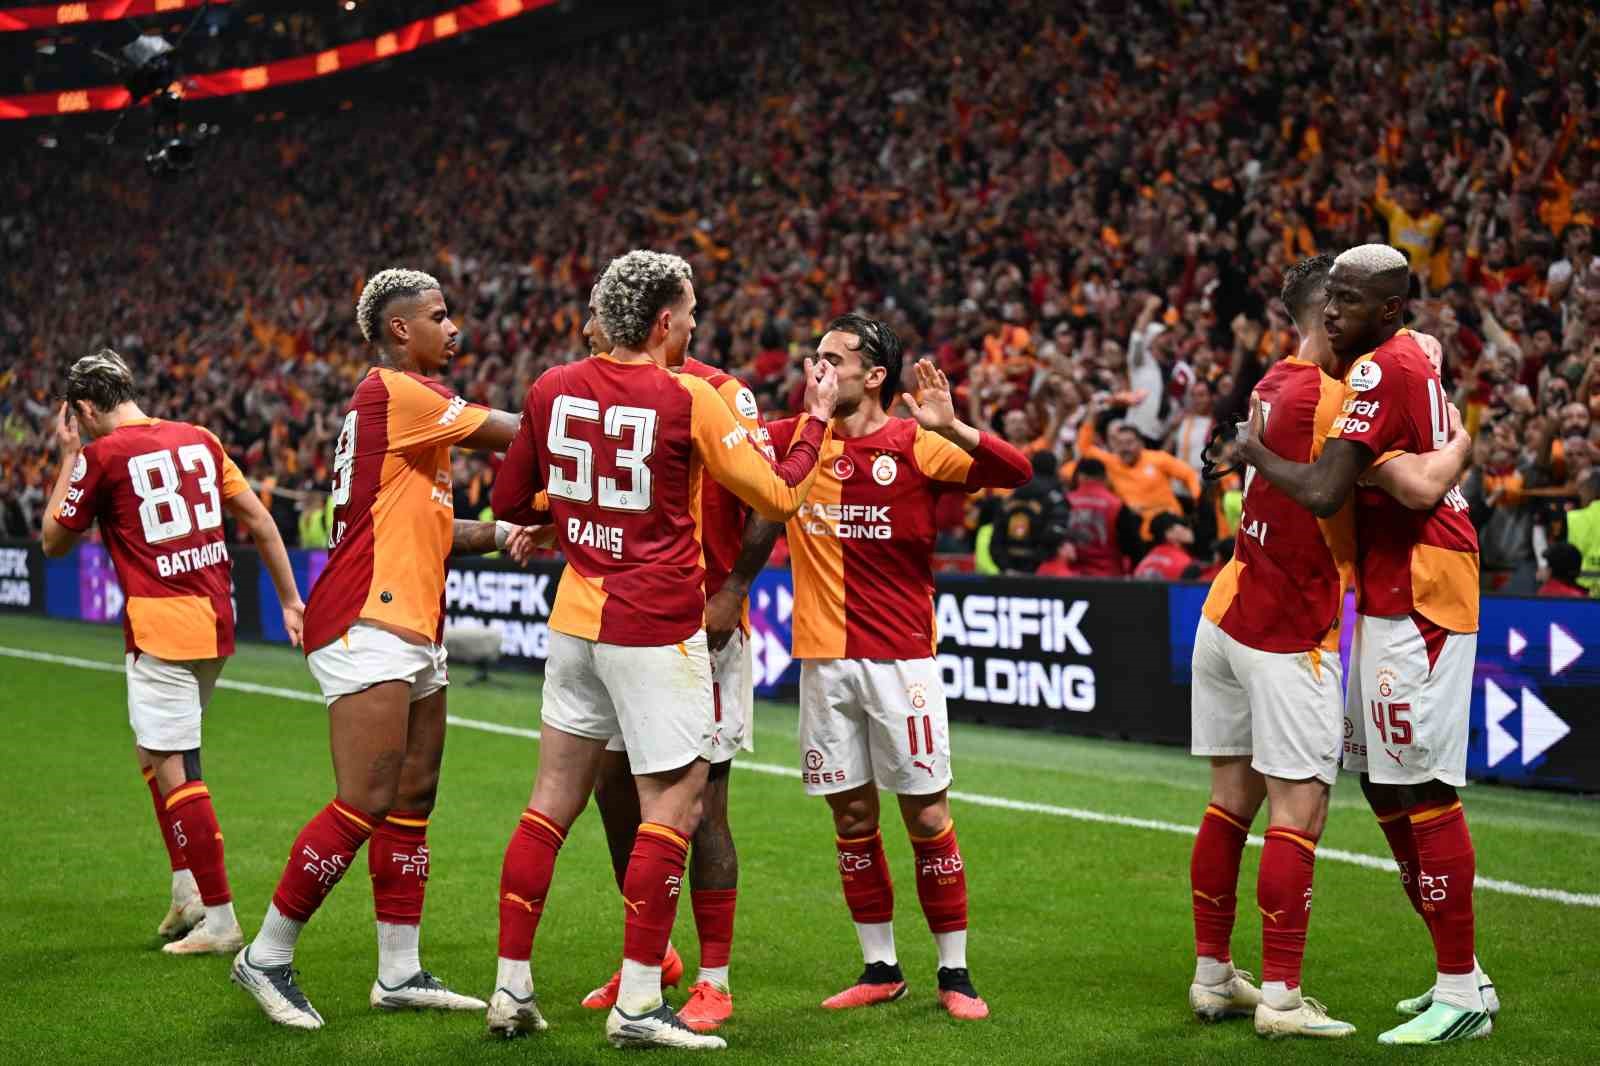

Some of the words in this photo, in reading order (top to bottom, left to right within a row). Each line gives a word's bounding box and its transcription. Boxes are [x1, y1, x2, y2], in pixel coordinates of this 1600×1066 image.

[547, 394, 659, 512] 53
[127, 443, 223, 544] 83
[936, 593, 1093, 655] ASiFiK
[936, 653, 1096, 713] OLDiNG
[906, 714, 934, 756] 11
[1370, 699, 1413, 745] 45
